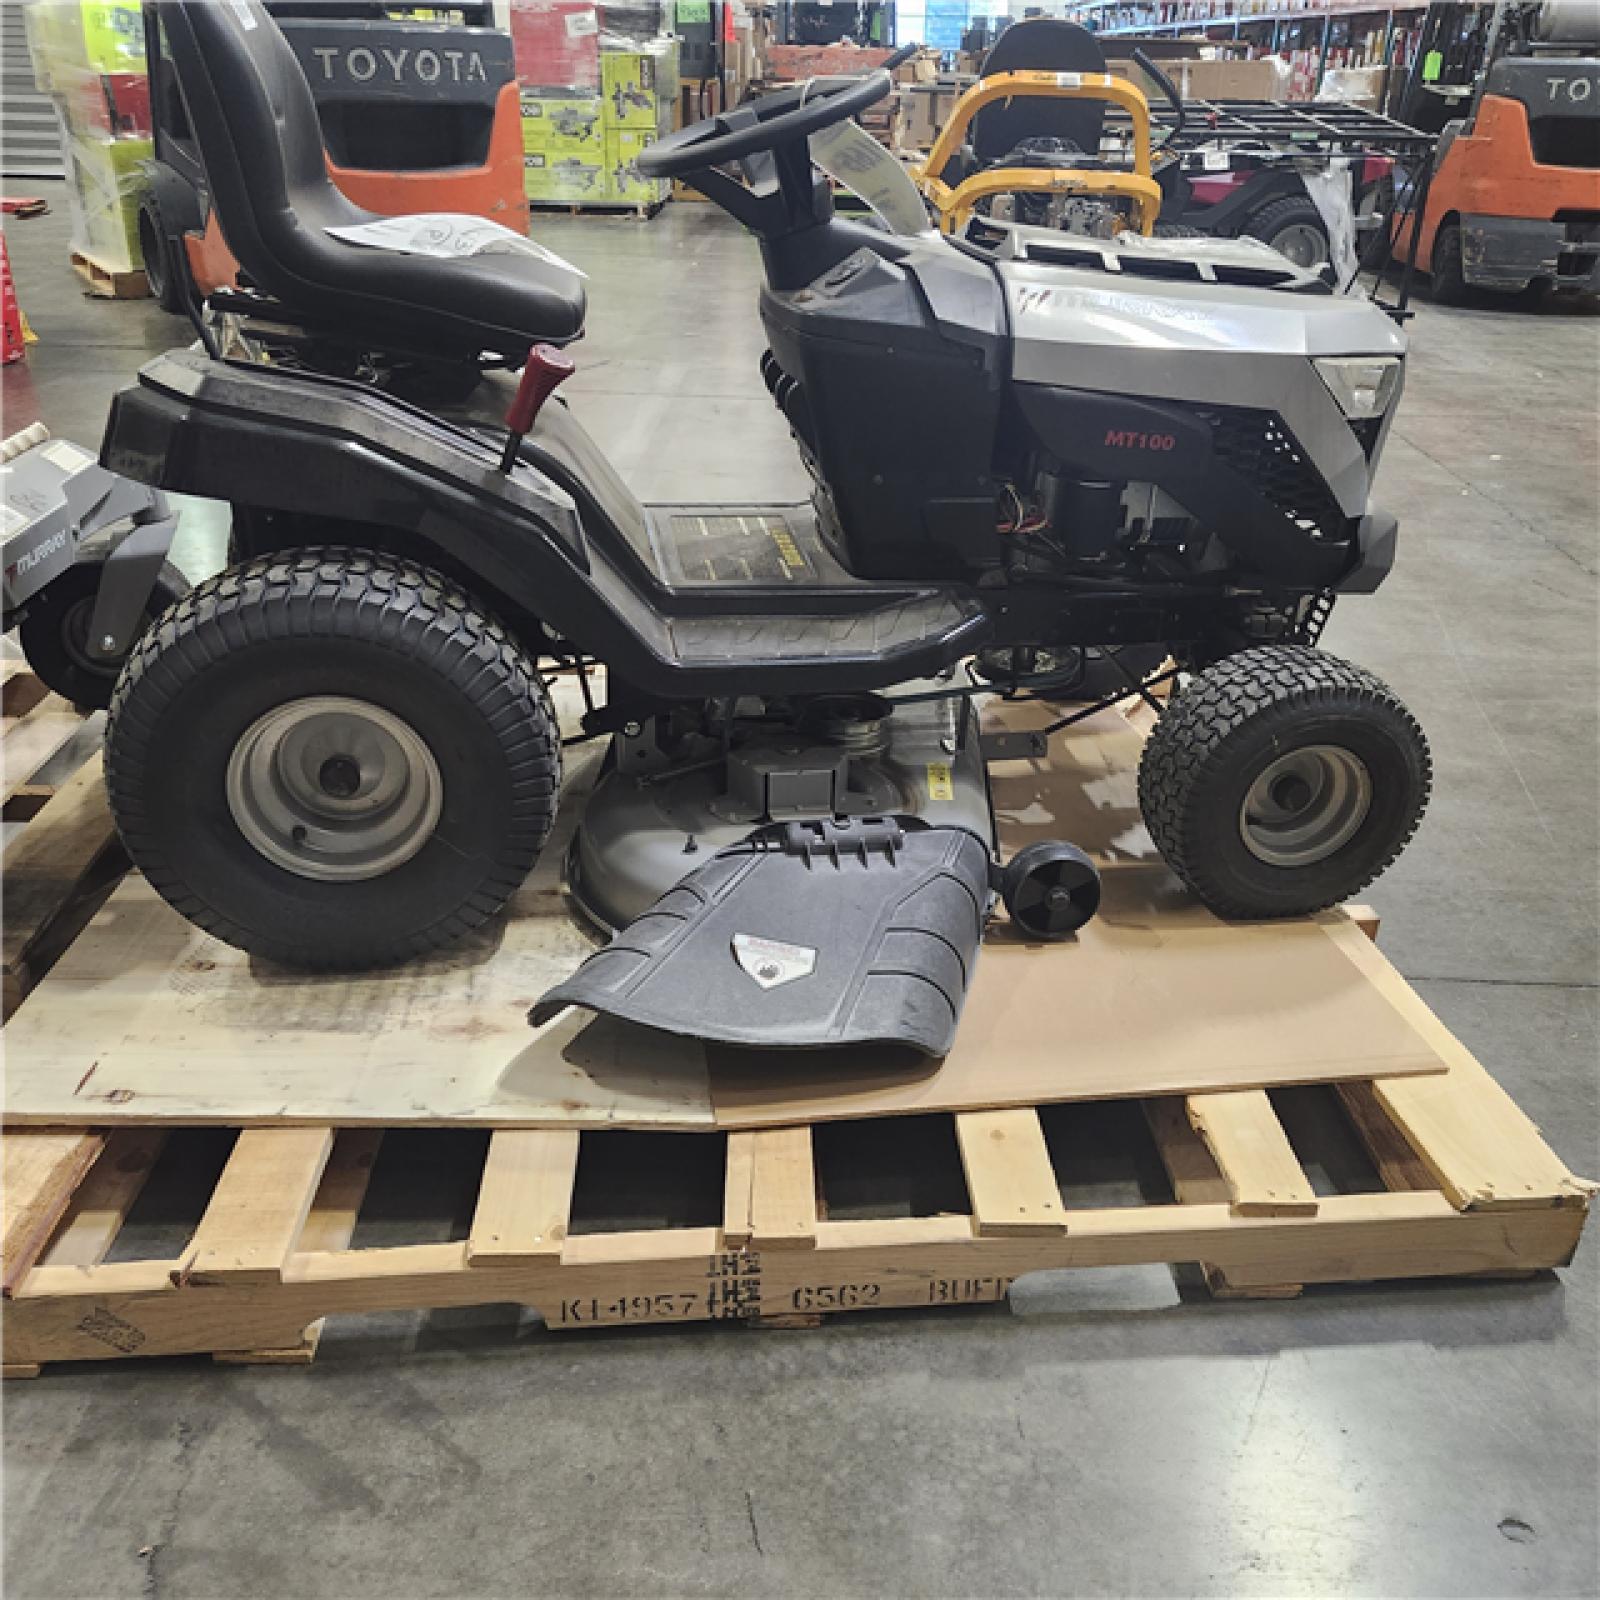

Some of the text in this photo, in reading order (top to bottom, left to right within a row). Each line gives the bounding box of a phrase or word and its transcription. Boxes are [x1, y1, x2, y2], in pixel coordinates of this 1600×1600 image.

[313, 48, 487, 82] TOYOTA
[1546, 77, 1600, 101] TO
[1104, 430, 1176, 451] MT100
